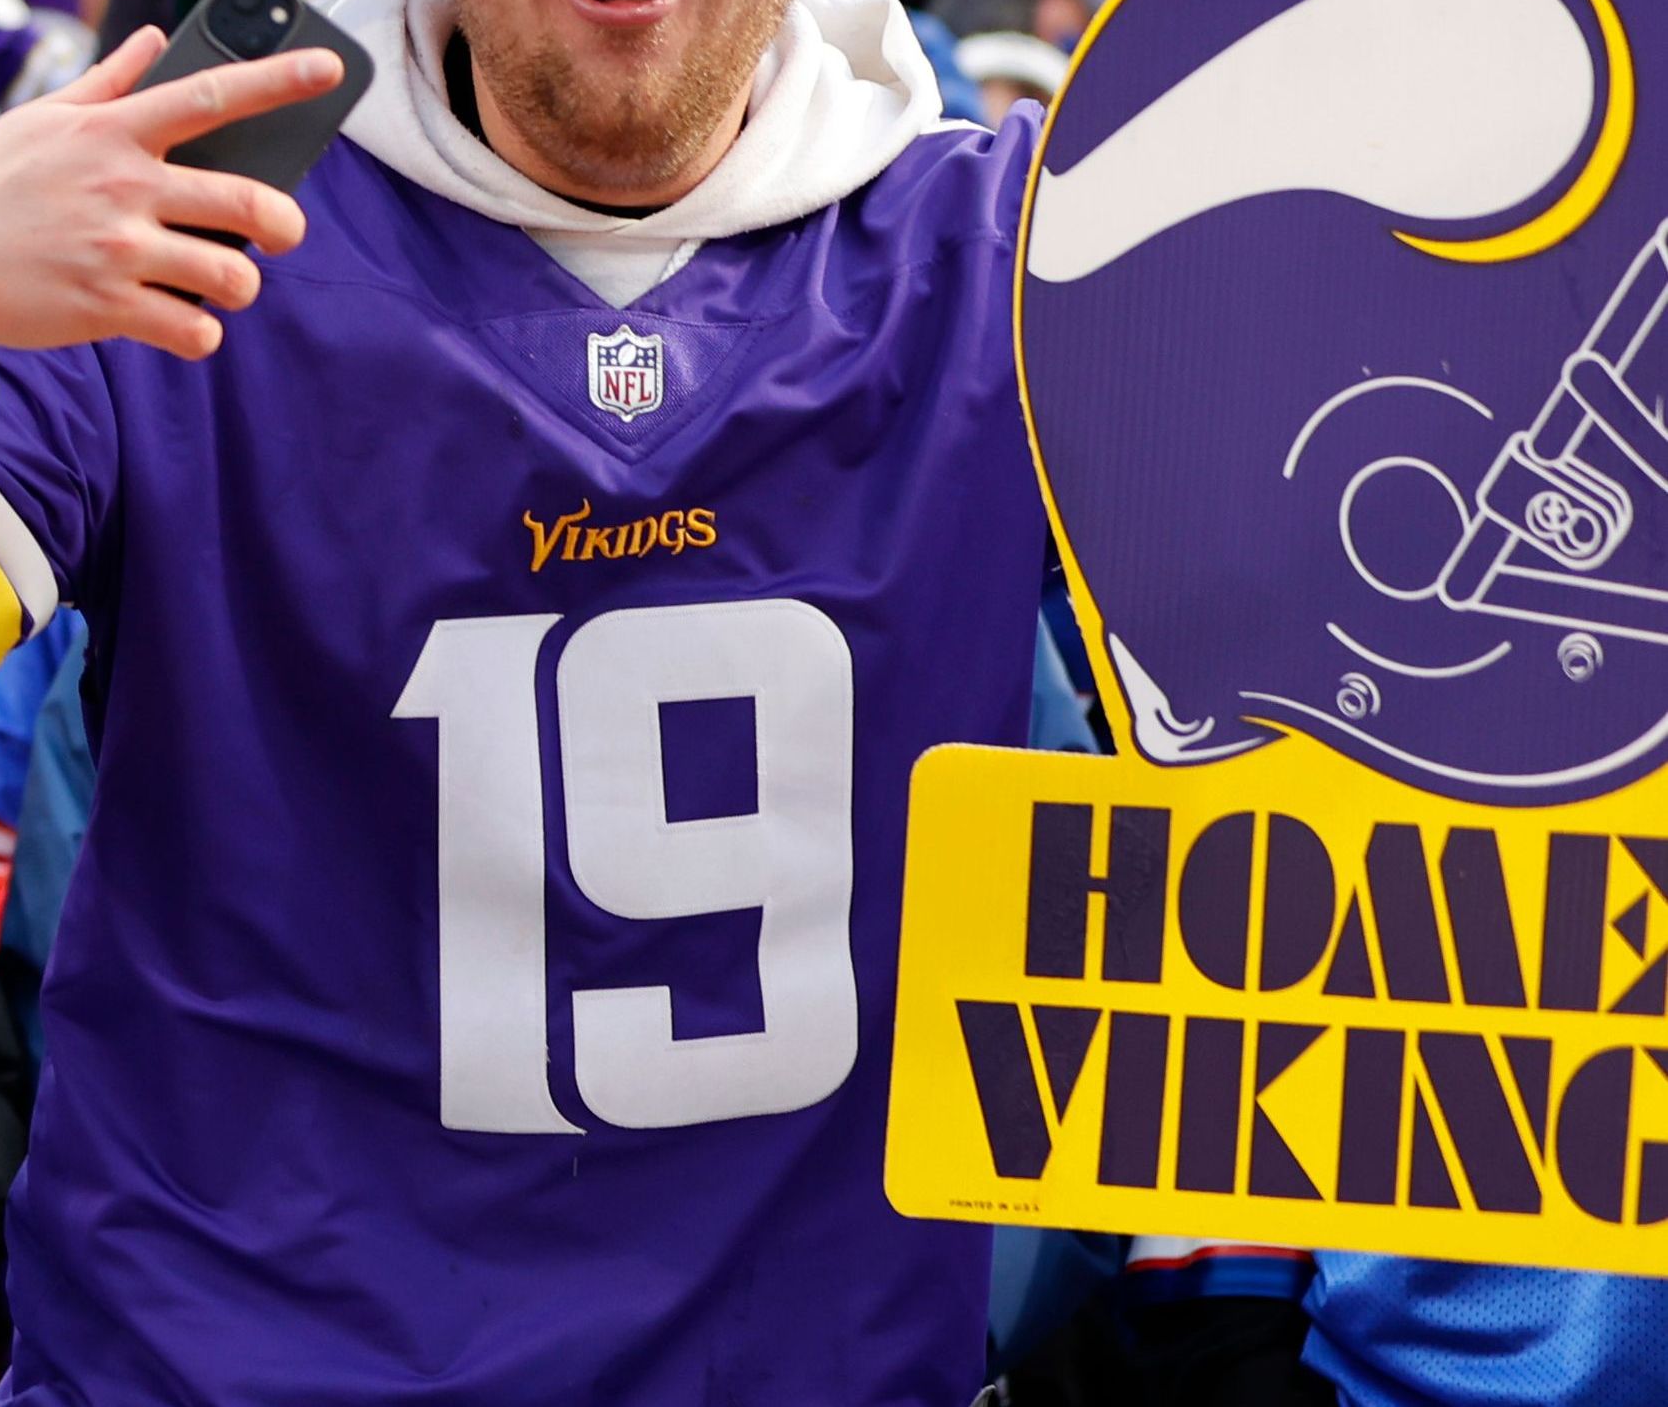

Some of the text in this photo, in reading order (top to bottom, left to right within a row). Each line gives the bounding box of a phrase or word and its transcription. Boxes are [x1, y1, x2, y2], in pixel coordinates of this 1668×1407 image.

[603, 370, 652, 406] NFL
[390, 598, 859, 1135] 19
[1024, 801, 1668, 1018] HOME
